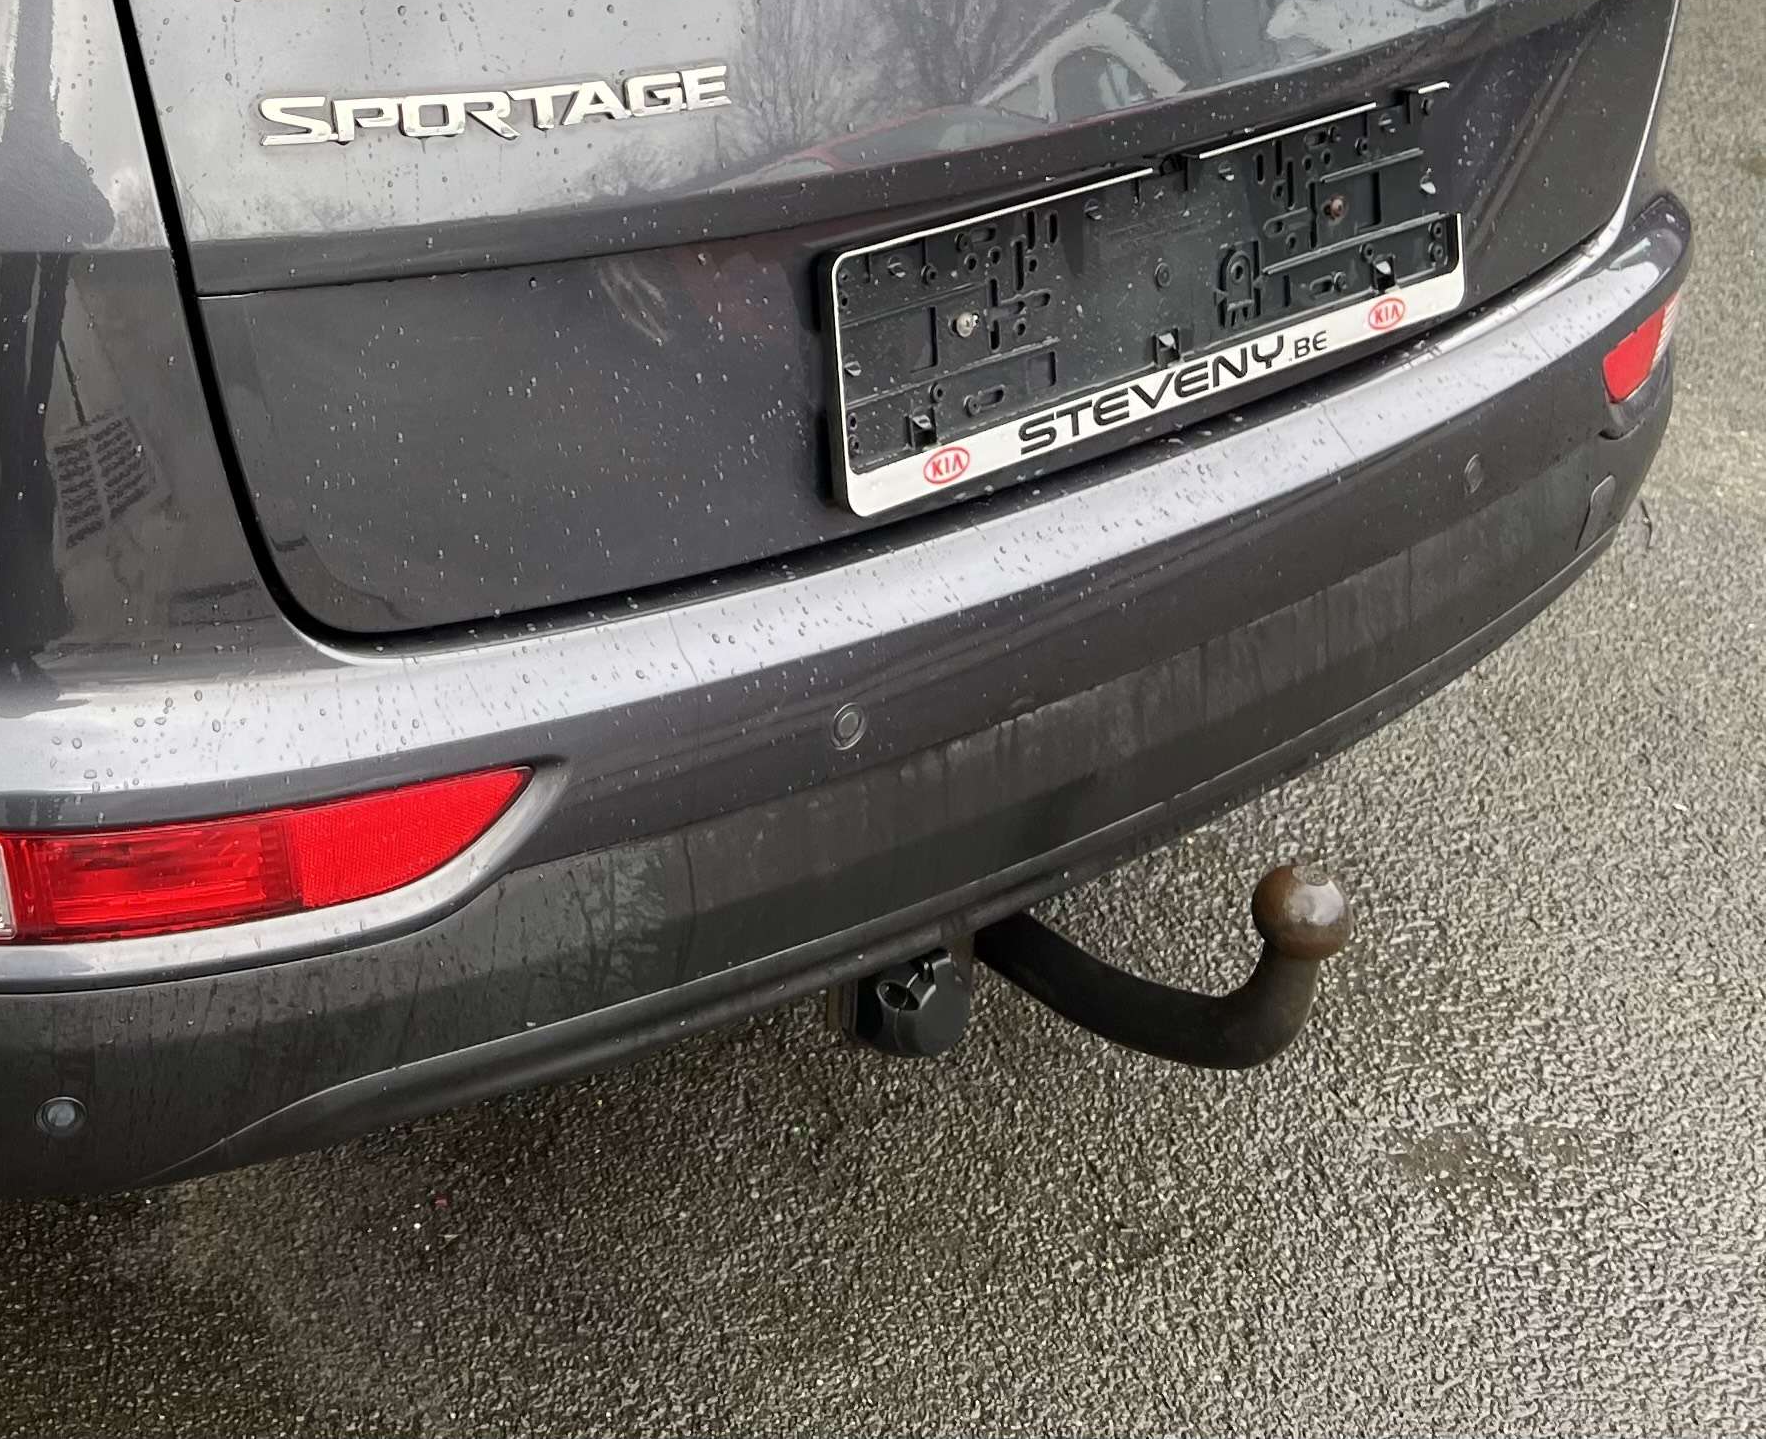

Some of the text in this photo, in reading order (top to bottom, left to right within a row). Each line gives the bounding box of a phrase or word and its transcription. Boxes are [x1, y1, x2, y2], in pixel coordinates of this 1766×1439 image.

[259, 65, 733, 147] SPORTAGE
[1374, 303, 1400, 325] KIA
[931, 453, 964, 480] KIA
